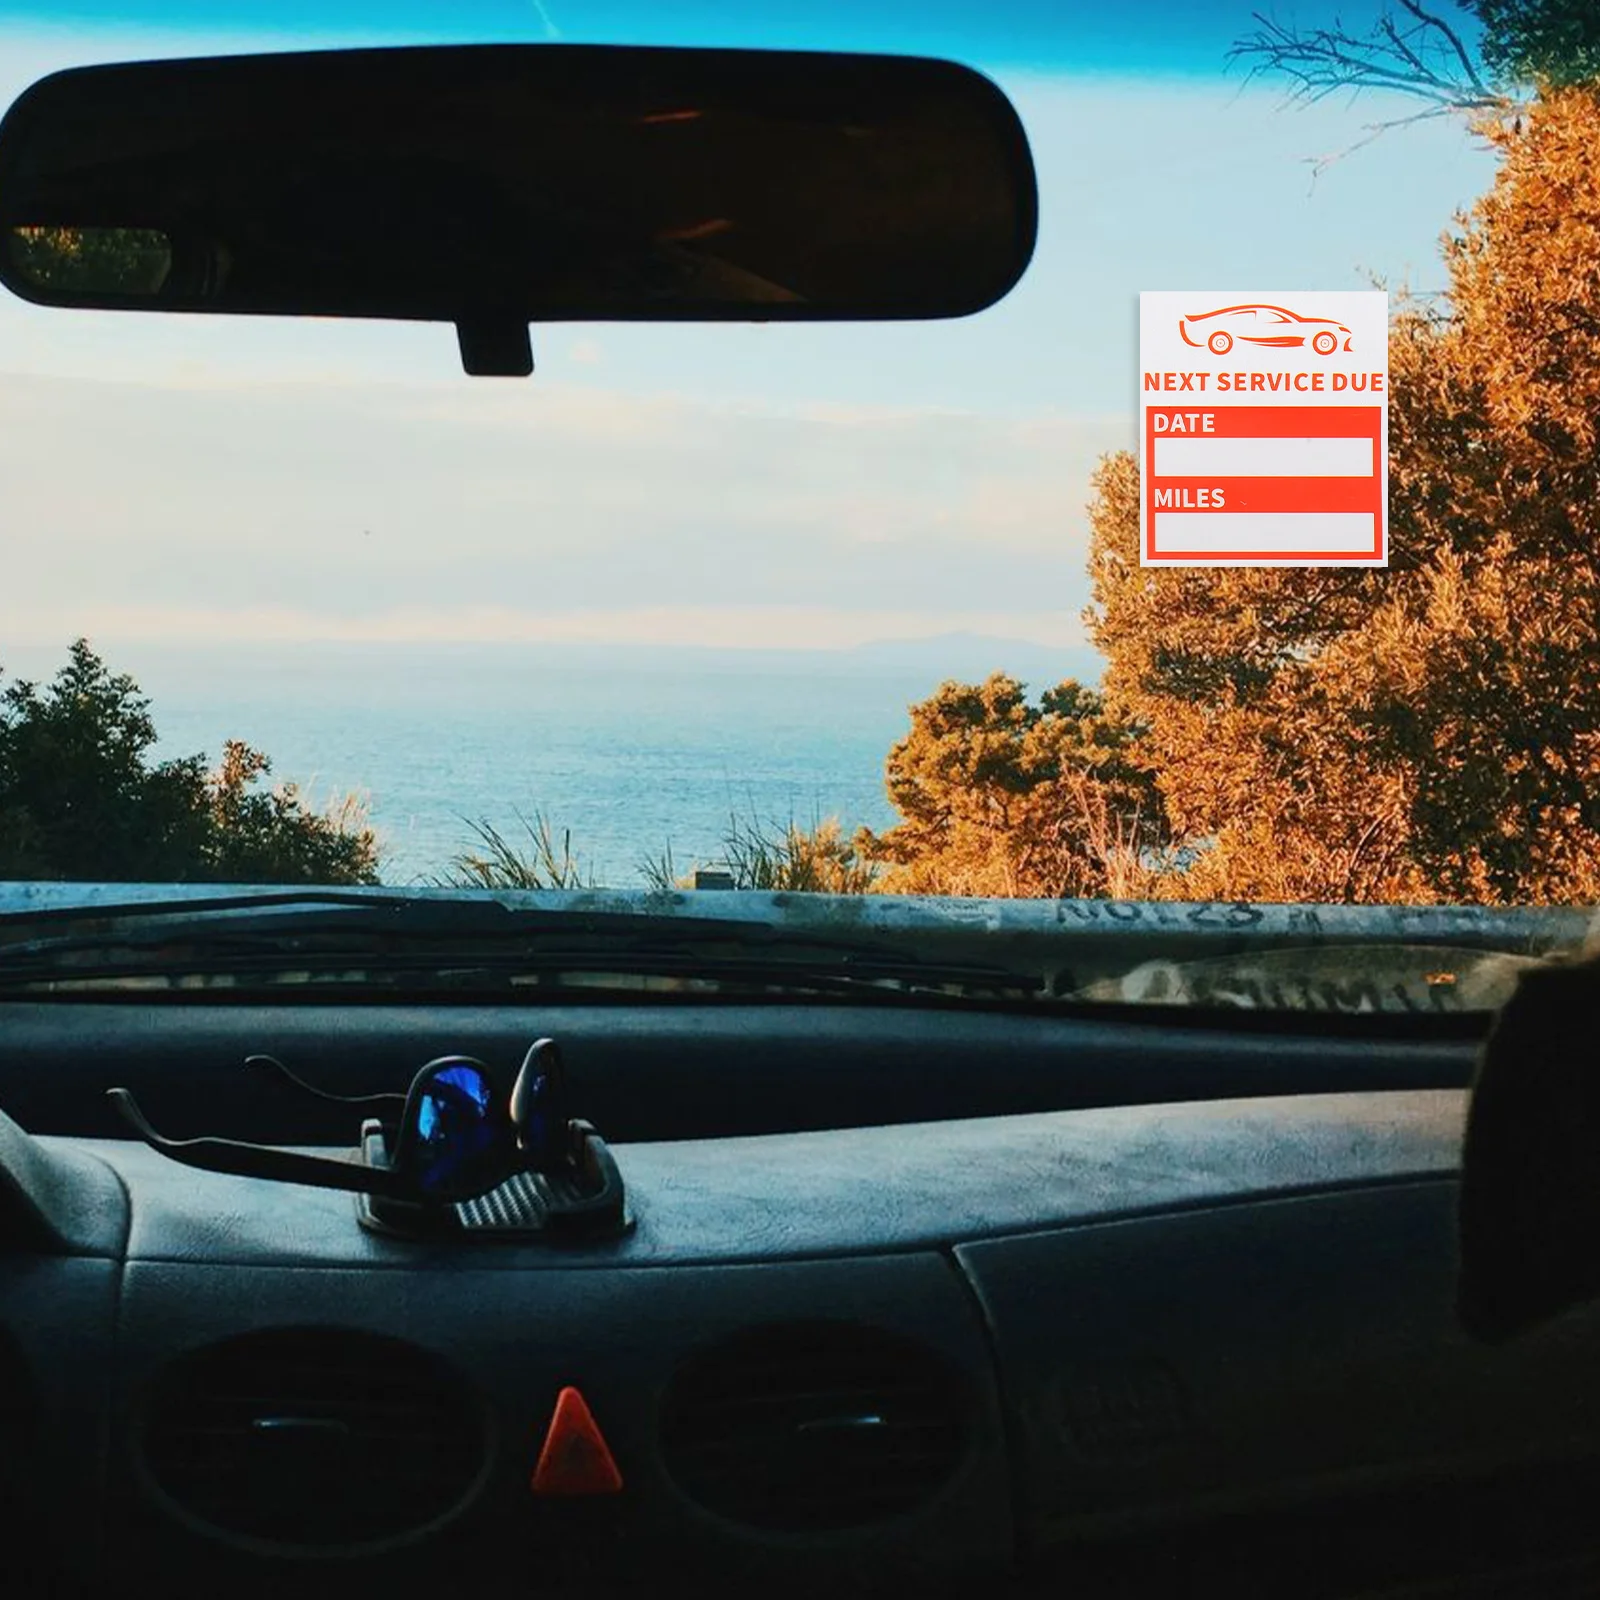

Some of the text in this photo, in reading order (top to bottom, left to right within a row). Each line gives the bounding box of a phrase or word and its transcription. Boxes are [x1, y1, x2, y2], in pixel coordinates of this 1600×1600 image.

[1144, 372, 1384, 392] NEXT SERVICE DUE
[1153, 413, 1216, 433] DATE
[1154, 488, 1226, 509] MILES
